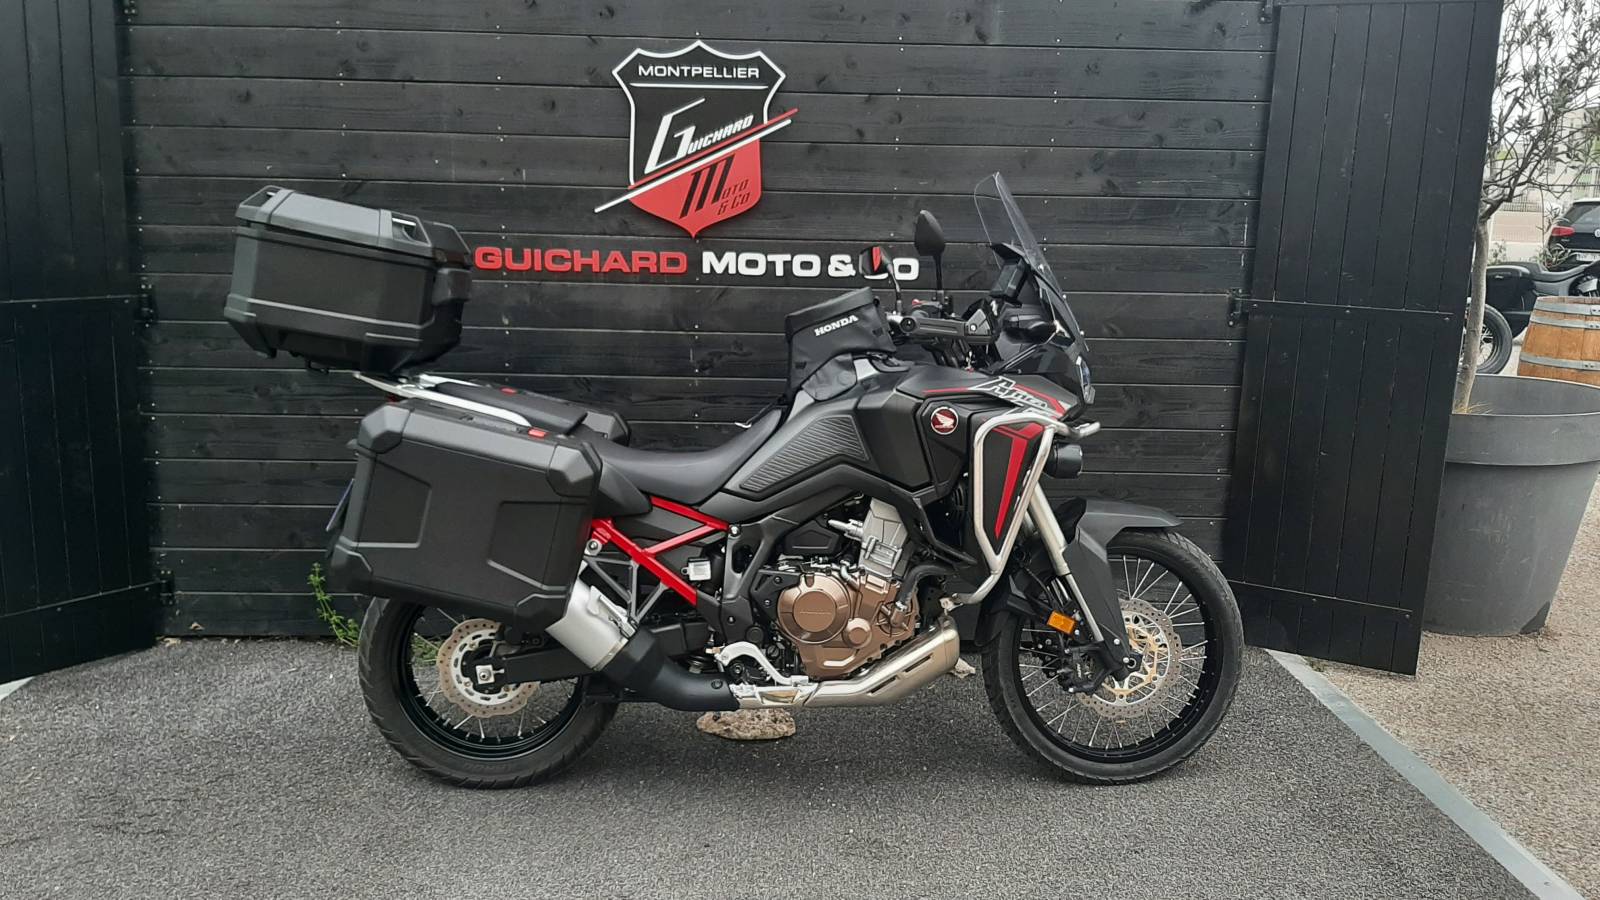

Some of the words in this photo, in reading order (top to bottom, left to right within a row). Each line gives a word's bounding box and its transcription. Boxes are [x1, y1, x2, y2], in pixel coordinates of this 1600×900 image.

[638, 64, 760, 79] MONTPELLIER
[644, 98, 754, 174] GUICHARD
[679, 153, 750, 219] MOTO
[717, 200, 730, 216] &
[731, 192, 751, 209] CO
[474, 246, 688, 275] GUICHARD
[702, 251, 821, 277] MOTO
[827, 254, 856, 277] &
[814, 315, 859, 336] HONDA
